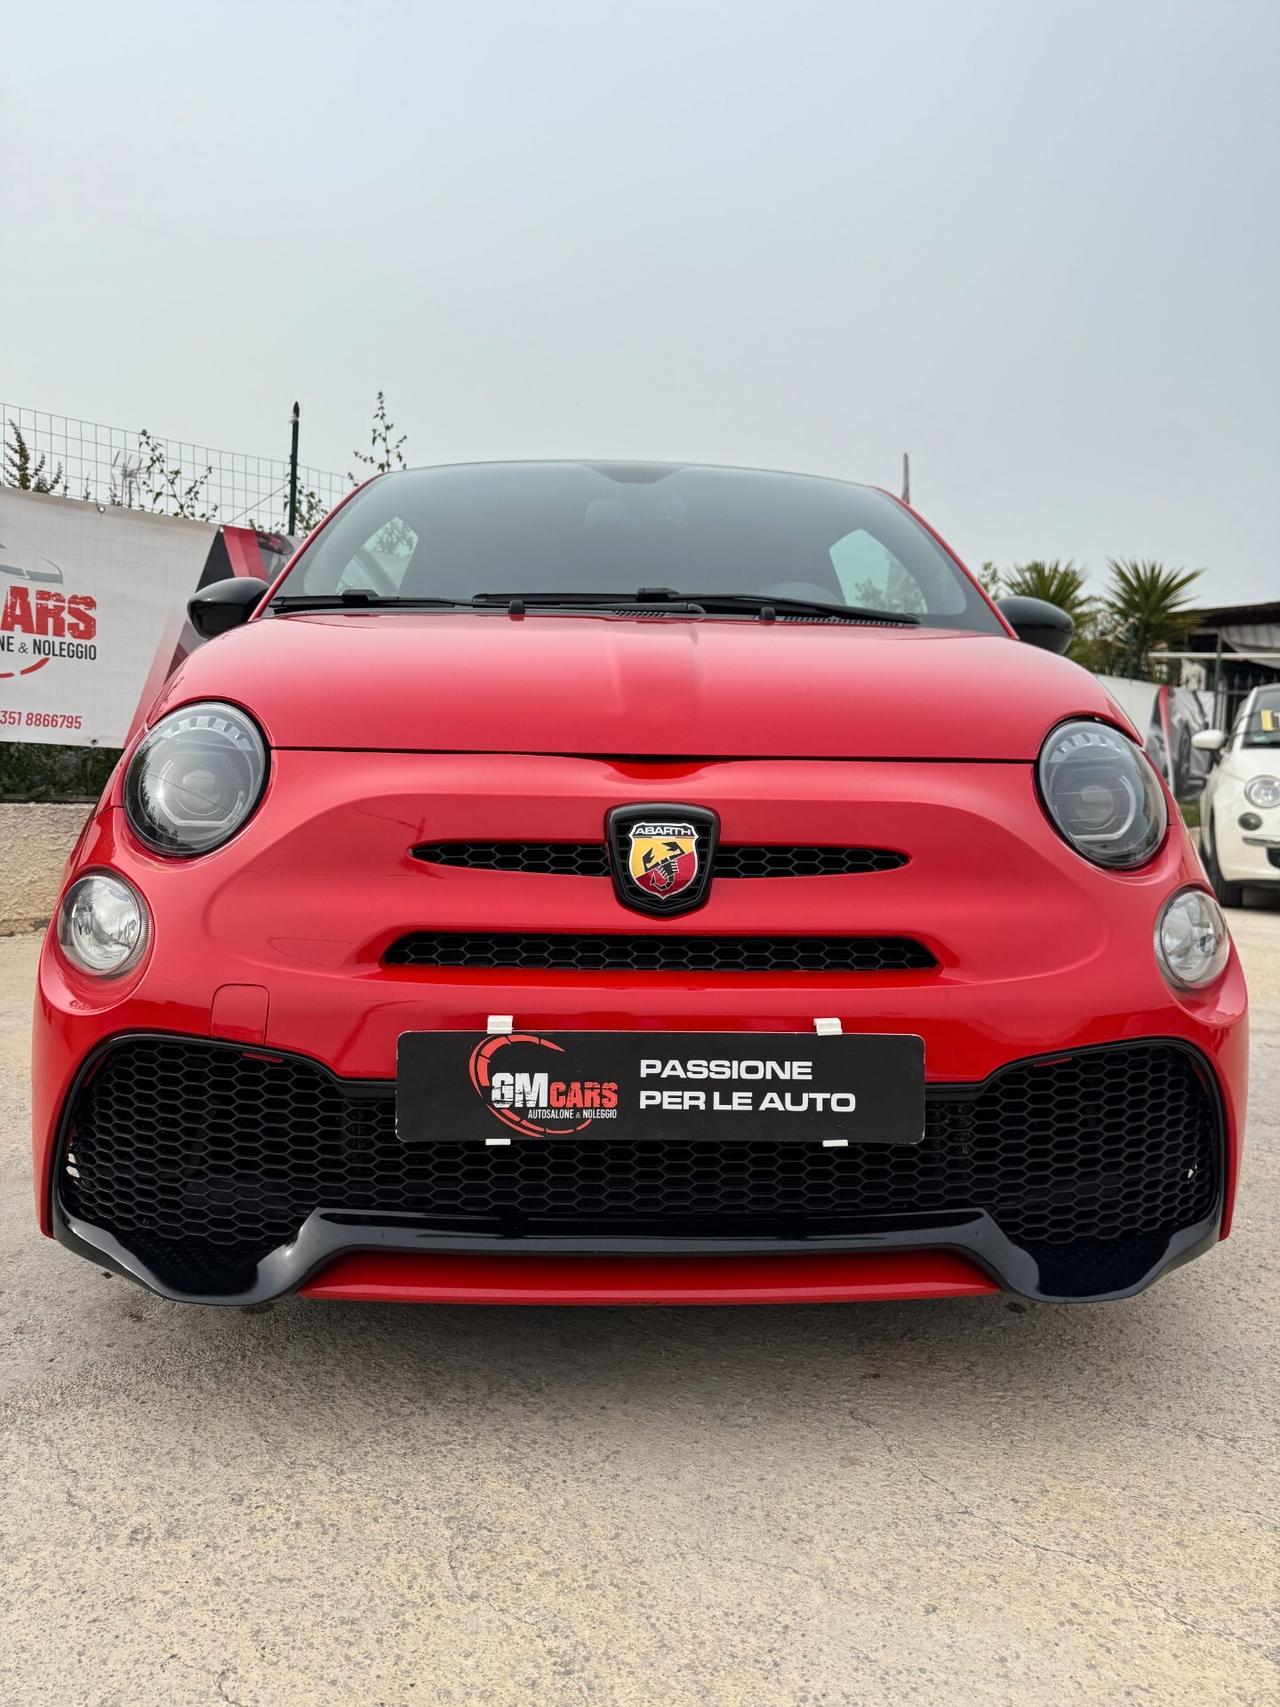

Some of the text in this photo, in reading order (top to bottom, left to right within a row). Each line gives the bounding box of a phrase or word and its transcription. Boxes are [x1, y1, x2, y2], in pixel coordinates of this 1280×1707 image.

[33, 638, 97, 661] NOLEGGIO
[25, 712, 82, 729] 8866795
[635, 826, 691, 835] ABARTH
[639, 1059, 813, 1080] PASSIONE
[639, 1090, 857, 1113] PER LE AUTO
[528, 1109, 574, 1119] AUTOSALONE
[583, 1109, 617, 1119] NOLEGGIO
